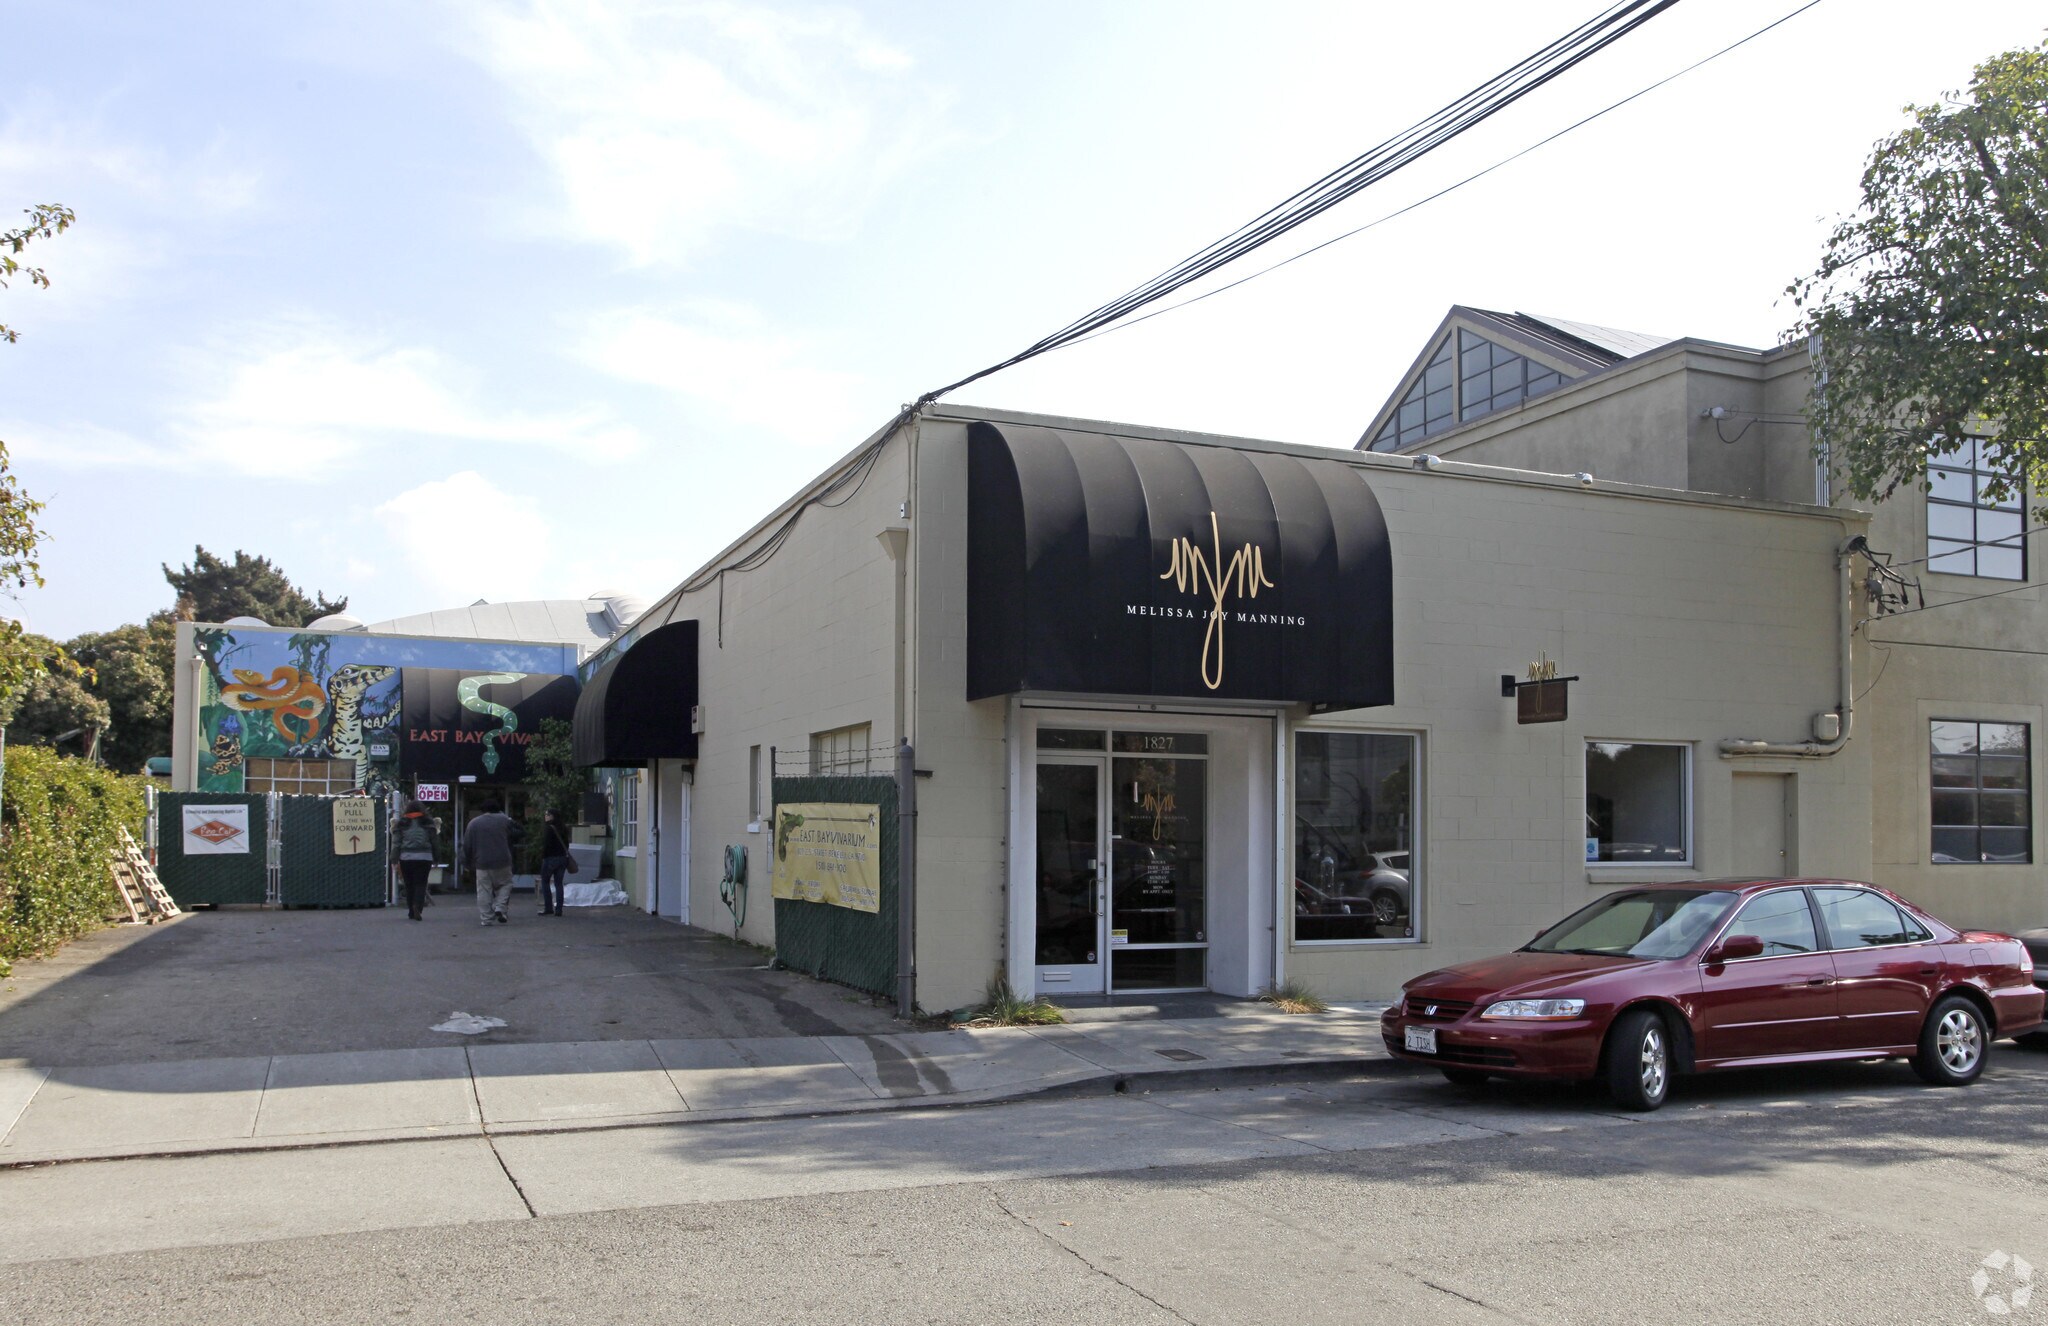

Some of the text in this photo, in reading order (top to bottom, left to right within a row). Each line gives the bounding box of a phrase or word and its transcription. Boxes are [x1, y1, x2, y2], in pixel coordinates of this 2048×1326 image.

[1127, 605, 1194, 618] MELISSA
[1237, 613, 1305, 626] MANNING
[410, 729, 447, 743] EAST
[455, 730, 485, 744] BAY
[1145, 736, 1173, 749] 1827
[418, 790, 448, 800] OPEN
